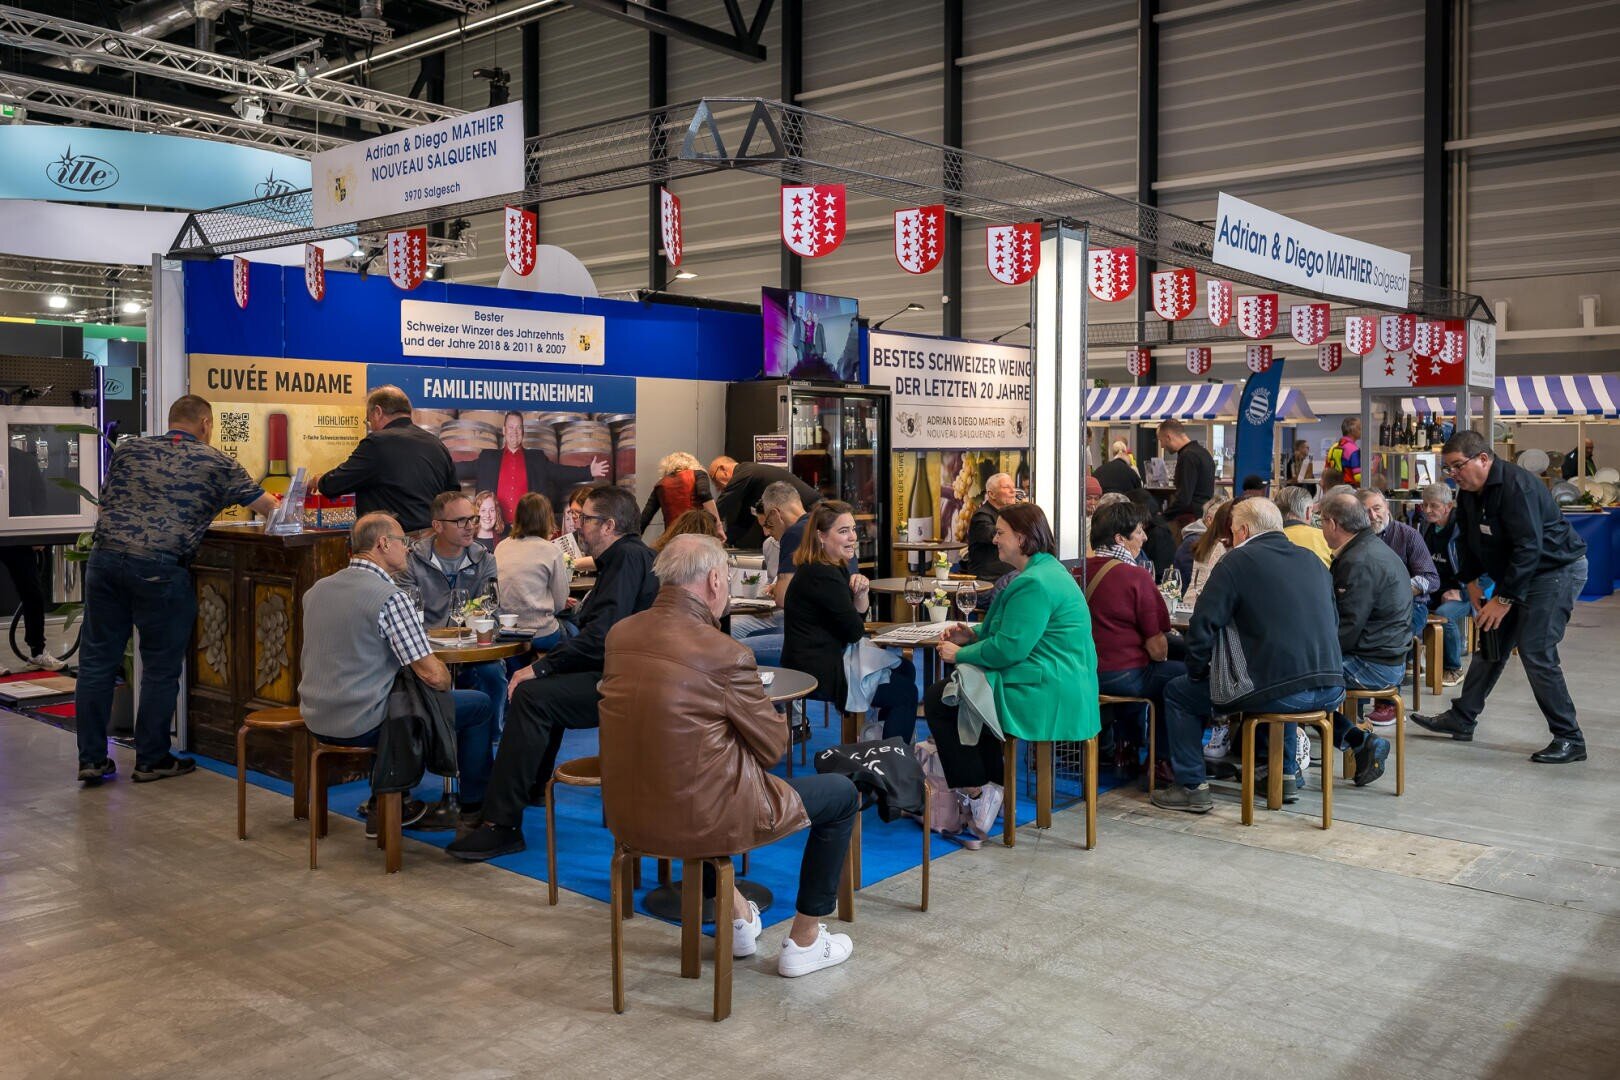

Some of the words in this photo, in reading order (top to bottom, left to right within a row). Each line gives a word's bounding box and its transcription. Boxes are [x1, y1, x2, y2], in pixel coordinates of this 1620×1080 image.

[365, 144, 400, 162] Adrian
[403, 137, 411, 152] &
[414, 130, 448, 149] Diego
[452, 114, 504, 140] MATHIER
[371, 157, 424, 181] NOUVEAU
[427, 140, 497, 169] SALQUENEN
[404, 188, 422, 202] 3970
[424, 181, 461, 198] Salgesch
[1218, 215, 1267, 257] Adrian
[1271, 232, 1281, 261] &
[1285, 237, 1324, 278] Diego
[1326, 250, 1373, 285] MATHIER
[1373, 266, 1407, 293] Salgesch
[474, 310, 504, 323] Bester
[406, 320, 459, 334] Schweizer
[461, 324, 494, 336] Winzer
[496, 326, 514, 338] des
[516, 328, 565, 341] Jahrzehnts
[404, 336, 424, 347] und
[427, 337, 445, 347] der
[447, 338, 476, 349] Jahre
[478, 339, 500, 351] 2018
[503, 341, 510, 351] &
[512, 342, 534, 353] 2011
[536, 343, 543, 353] &
[545, 343, 567, 355] 2007
[873, 347, 925, 370] BESTES
[928, 352, 996, 376] SCHWEIZER
[998, 358, 1031, 378] WEING
[207, 363, 268, 391] CUVÉE
[275, 371, 353, 395] MADAME
[423, 378, 593, 403] FAMILIENUNTERNEHMEN
[895, 376, 921, 396] DER
[924, 380, 977, 399] LETZTEN
[980, 382, 993, 400] 20
[996, 383, 1030, 401] JAHRE
[317, 415, 359, 426] HIGHLIGHTS
[927, 415, 951, 426] ADRIAN
[952, 416, 957, 426] &
[958, 416, 978, 427] DIEGO
[978, 416, 1005, 427] MATHIER
[926, 429, 958, 439] NOUVEAU
